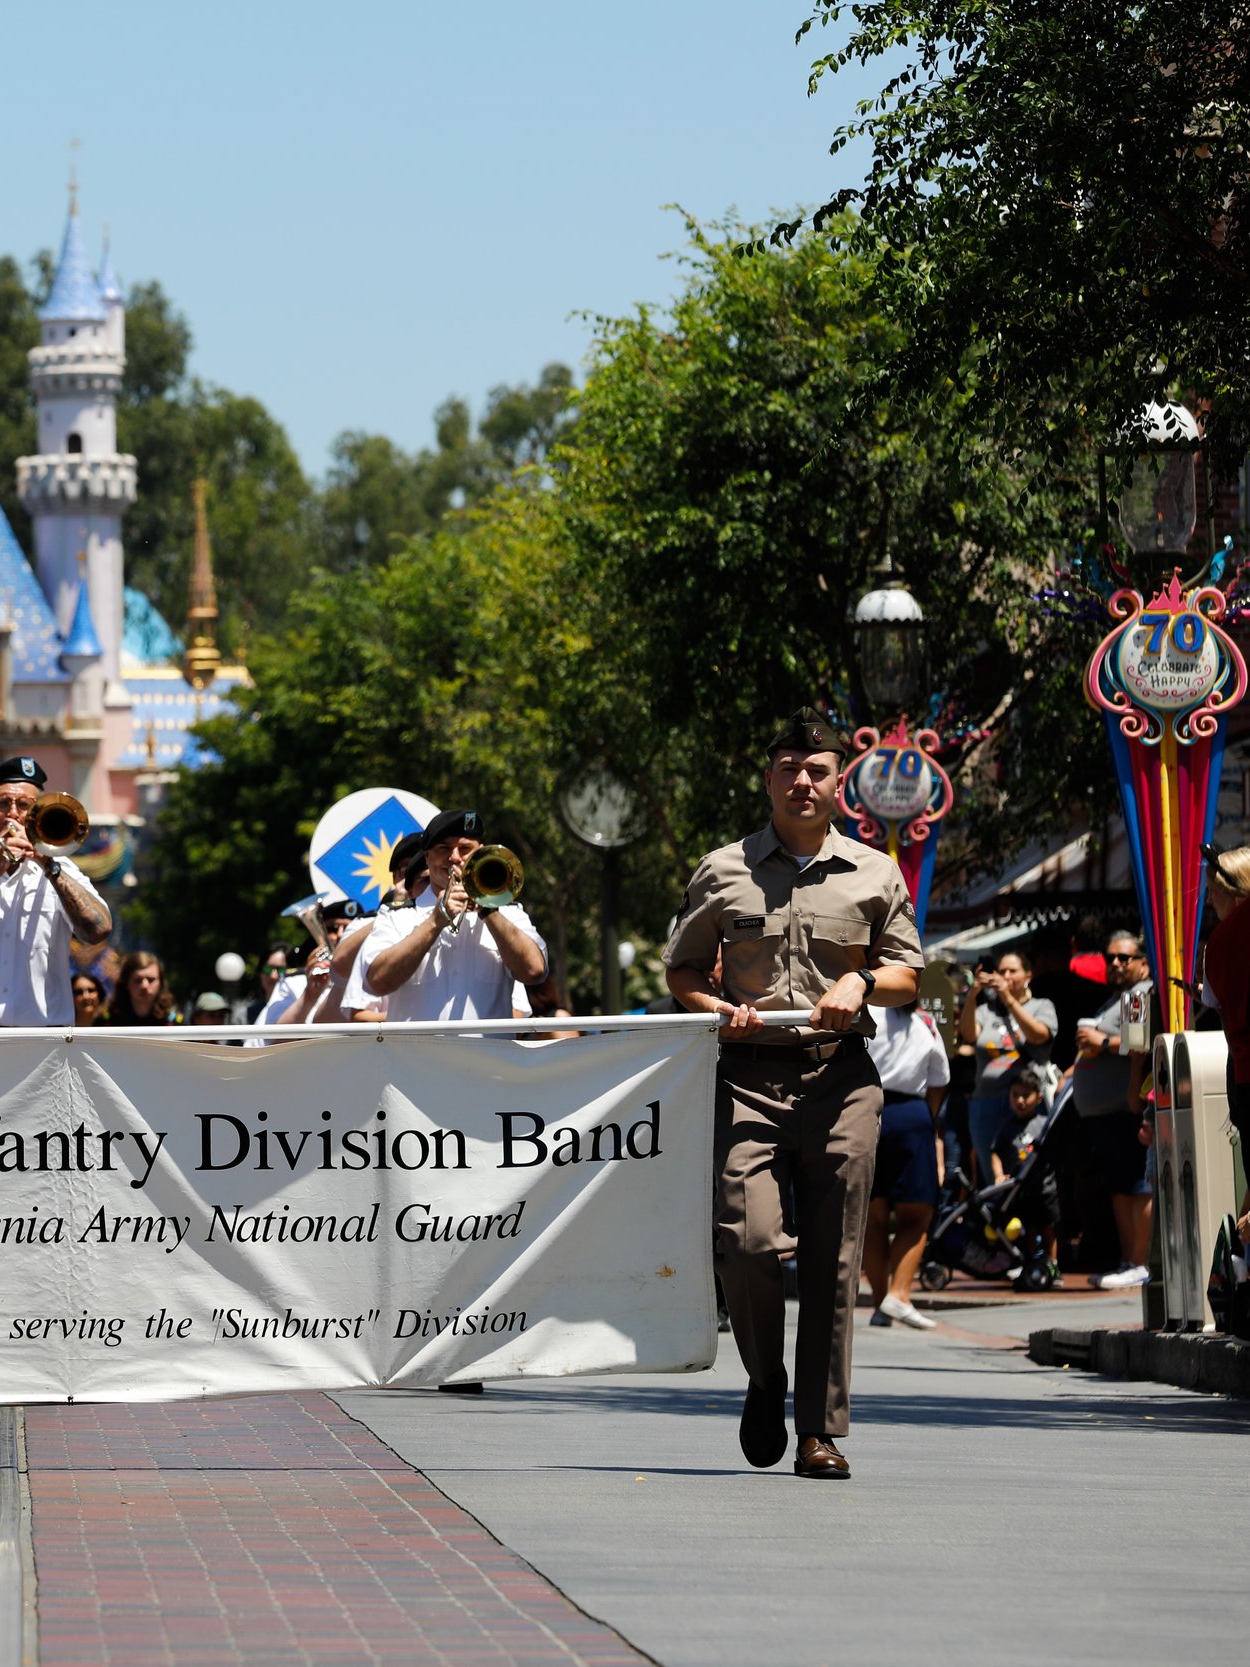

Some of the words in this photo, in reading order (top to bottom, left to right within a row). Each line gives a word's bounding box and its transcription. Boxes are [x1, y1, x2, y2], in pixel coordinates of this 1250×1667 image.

[1140, 610, 1206, 655] 70
[876, 748, 922, 778] 70
[194, 1110, 472, 1171] Division
[494, 1099, 664, 1169] Band
[76, 1205, 191, 1254] Army
[203, 1202, 381, 1243] National
[395, 1200, 527, 1243] Guard
[9, 1309, 126, 1347] serving
[145, 1308, 193, 1339] the
[211, 1308, 381, 1339] "Sunburst"
[392, 1305, 528, 1339] Division
